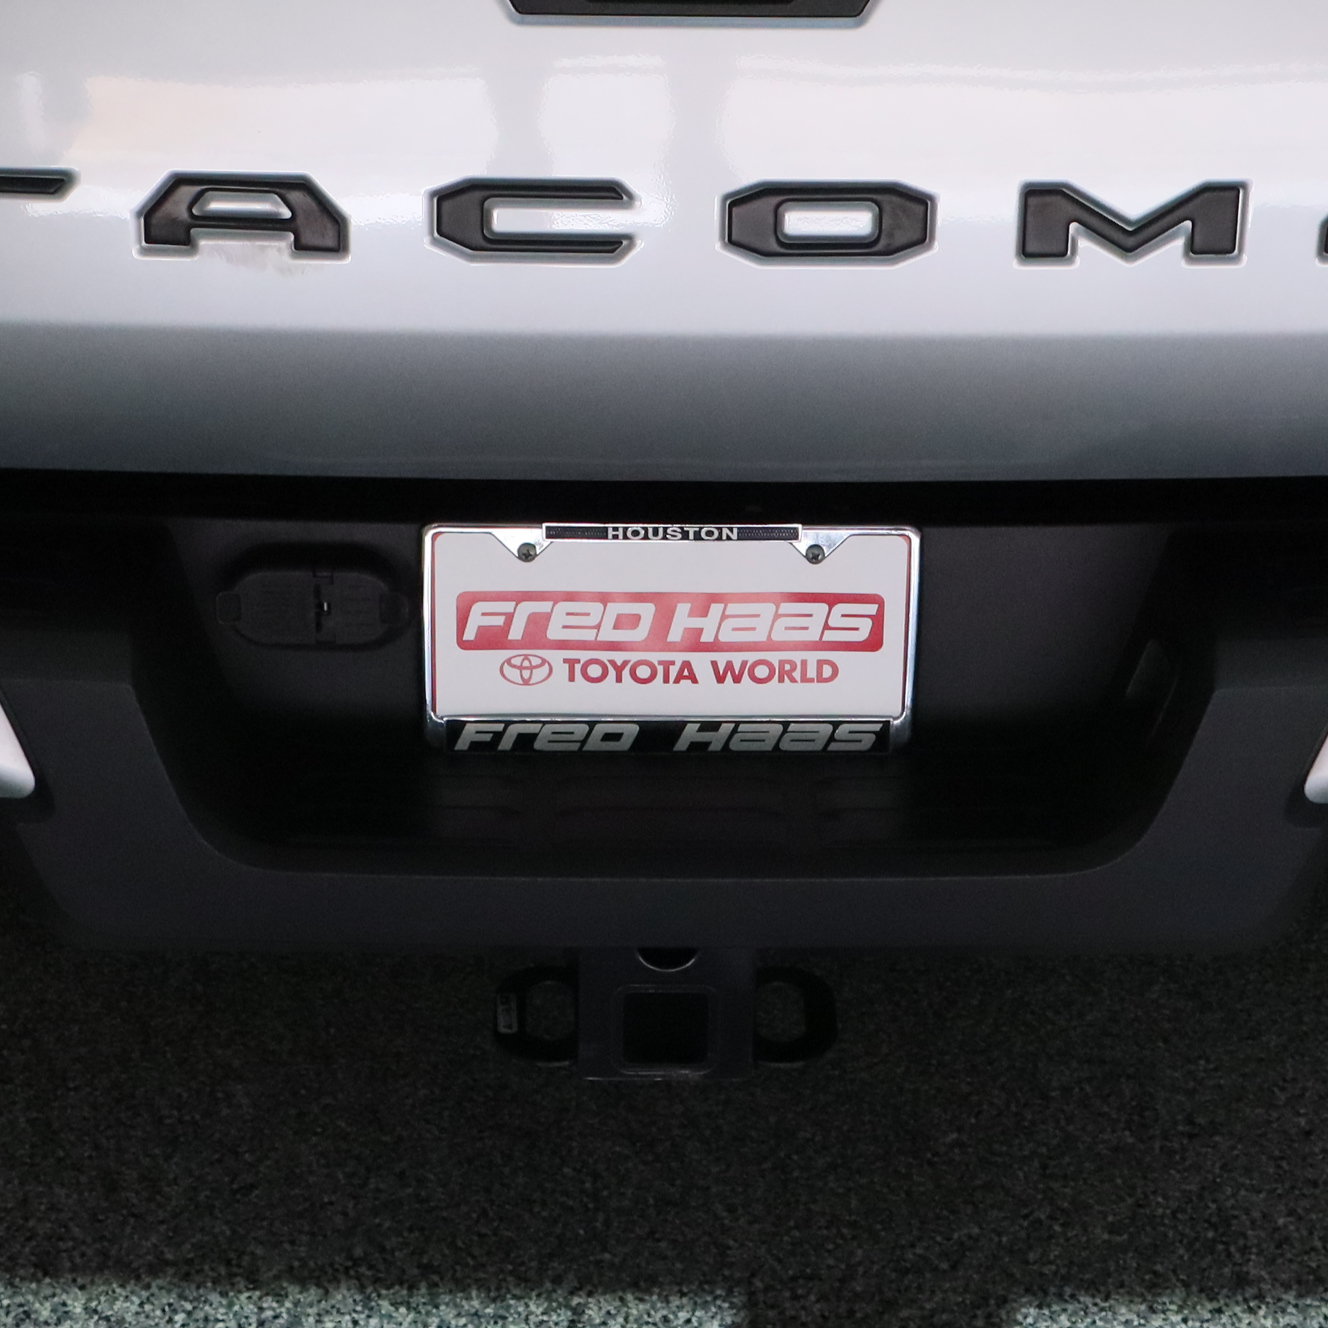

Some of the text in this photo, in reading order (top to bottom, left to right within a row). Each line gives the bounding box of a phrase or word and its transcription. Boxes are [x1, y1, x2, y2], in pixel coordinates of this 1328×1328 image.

[606, 525, 739, 542] HOUSTON
[562, 657, 840, 685] TOYOTA WORLD
